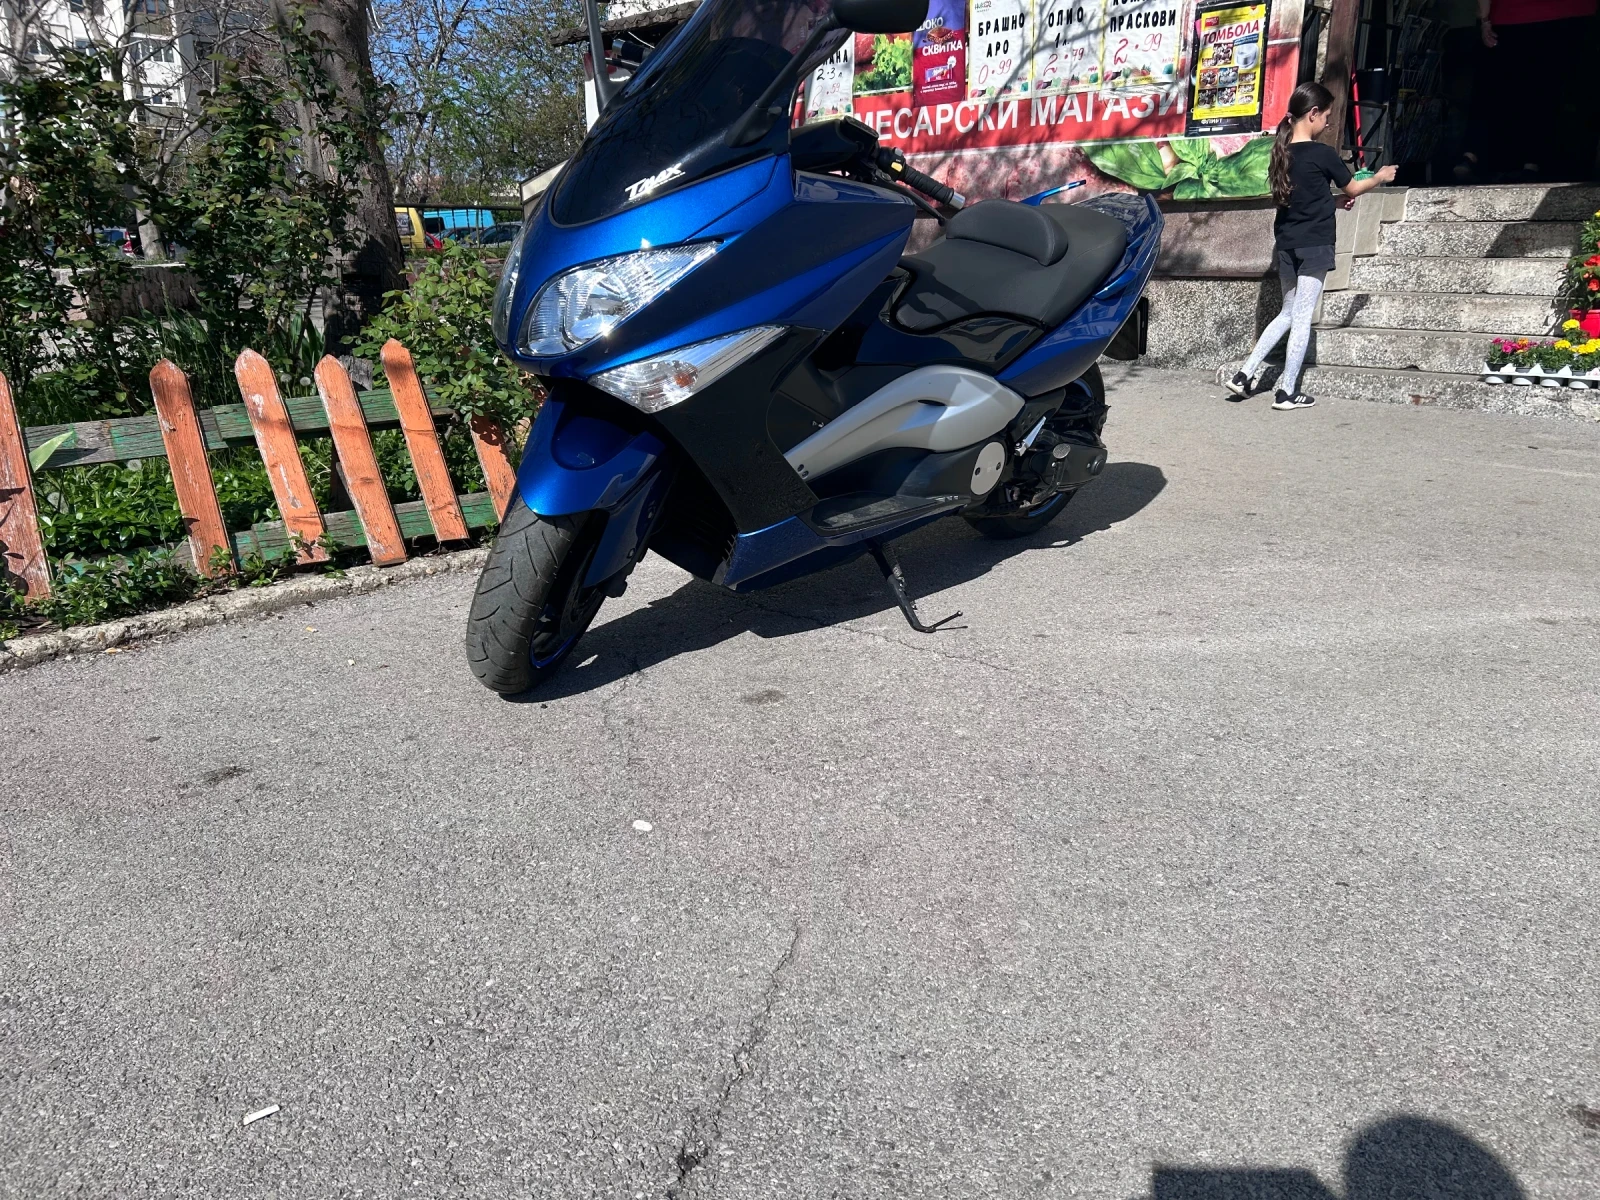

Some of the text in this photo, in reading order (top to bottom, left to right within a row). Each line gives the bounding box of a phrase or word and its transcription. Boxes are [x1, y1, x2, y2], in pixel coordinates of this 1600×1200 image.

[978, 12, 1025, 37] БРАШНО
[1048, 6, 1084, 28] ОЛИО
[1110, 9, 1176, 33] ПРАСКОВИ
[1055, 32, 1061, 49] 1
[1203, 20, 1260, 46] ТОМБОЛА
[986, 39, 1009, 58] АРО
[1113, 32, 1163, 66] 2.99
[978, 58, 1012, 85] 0.99
